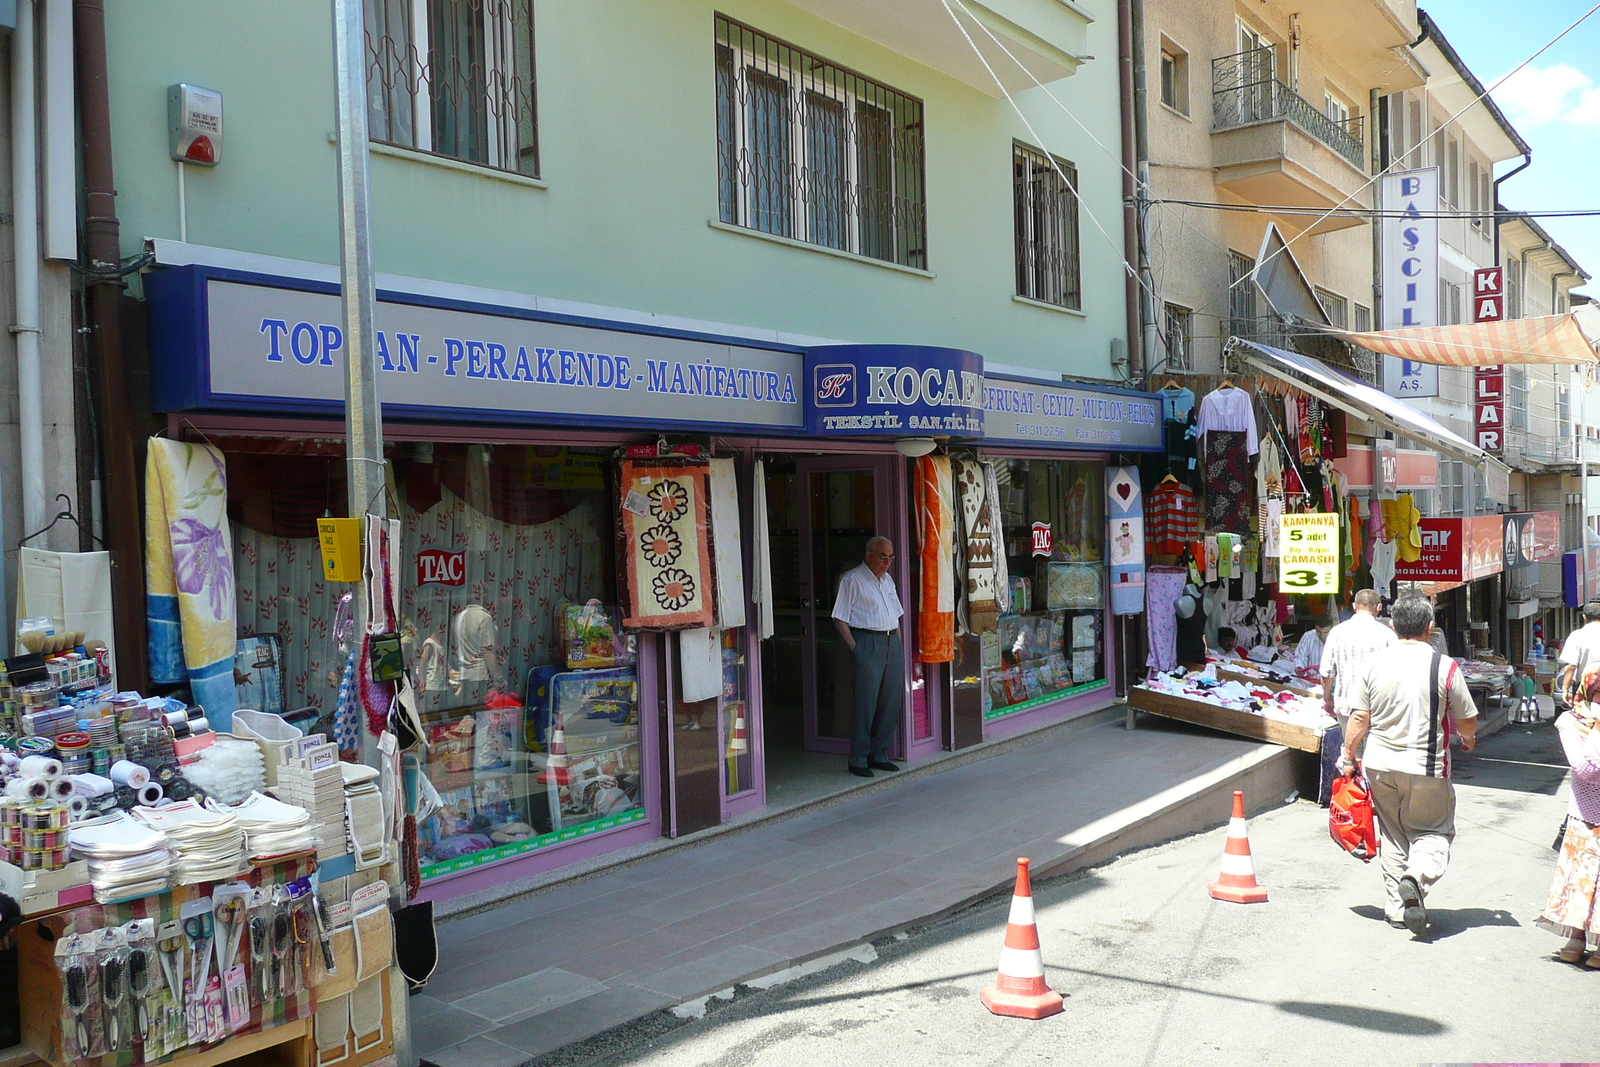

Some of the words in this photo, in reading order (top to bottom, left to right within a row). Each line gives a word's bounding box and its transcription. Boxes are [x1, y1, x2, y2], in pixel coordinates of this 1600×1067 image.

[1400, 176, 1423, 377] BAŞCILR
[259, 318, 422, 374] TOPAN
[444, 337, 631, 389] PERAKENDE
[645, 356, 796, 404] MANİFATURA
[1478, 273, 1499, 449] KALAR
[824, 410, 903, 429] TEKSTİL
[1128, 403, 1155, 428] PELUŞ
[1284, 516, 1335, 528] KAMPANYA
[1290, 529, 1303, 541] 5
[1307, 533, 1327, 541] adet
[1284, 570, 1319, 587] 3
[314, 752, 332, 764] PONZA
